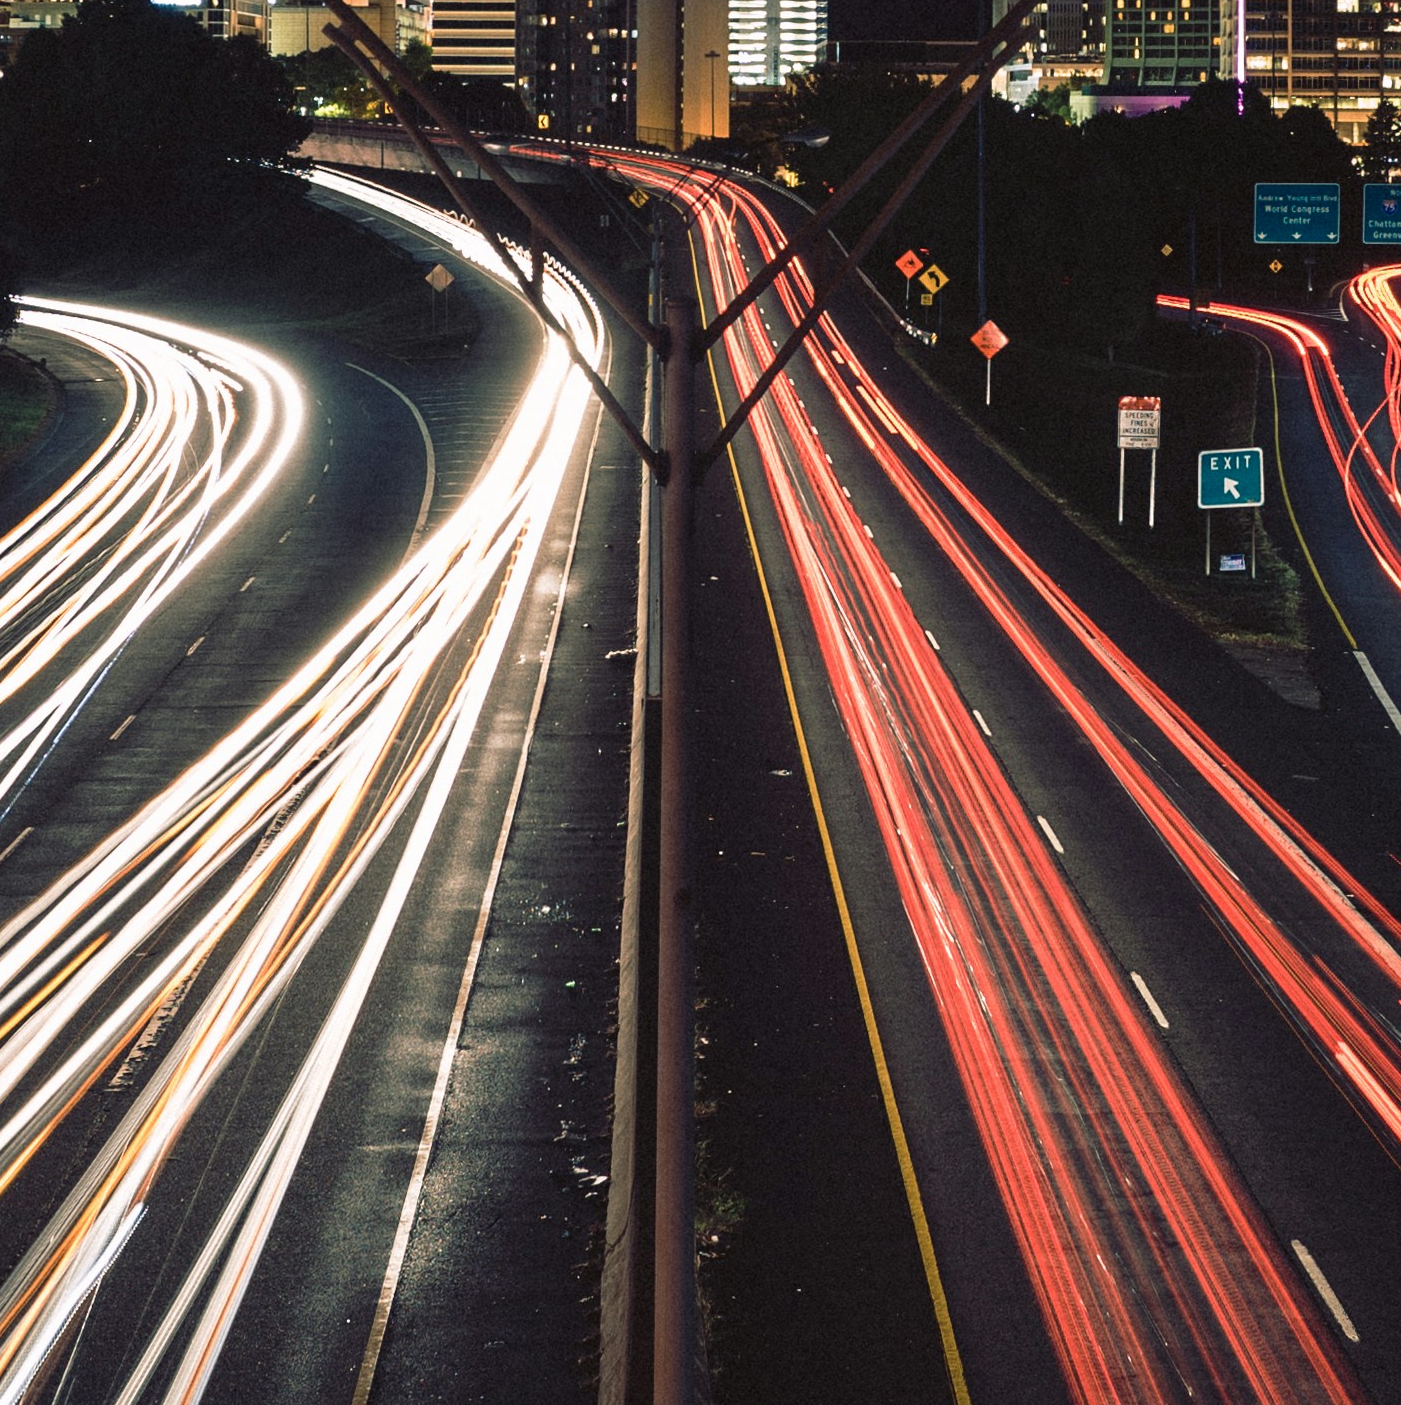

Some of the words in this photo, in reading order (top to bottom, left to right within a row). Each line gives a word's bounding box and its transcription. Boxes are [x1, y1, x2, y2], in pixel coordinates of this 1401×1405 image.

[1265, 204, 1288, 213] World
[1291, 204, 1330, 215] Congress
[1383, 203, 1396, 212] 75
[1282, 216, 1311, 224] Center
[1130, 419, 1148, 427] FINES
[1122, 427, 1156, 435] INCREASED
[1210, 455, 1251, 471] EXIT
